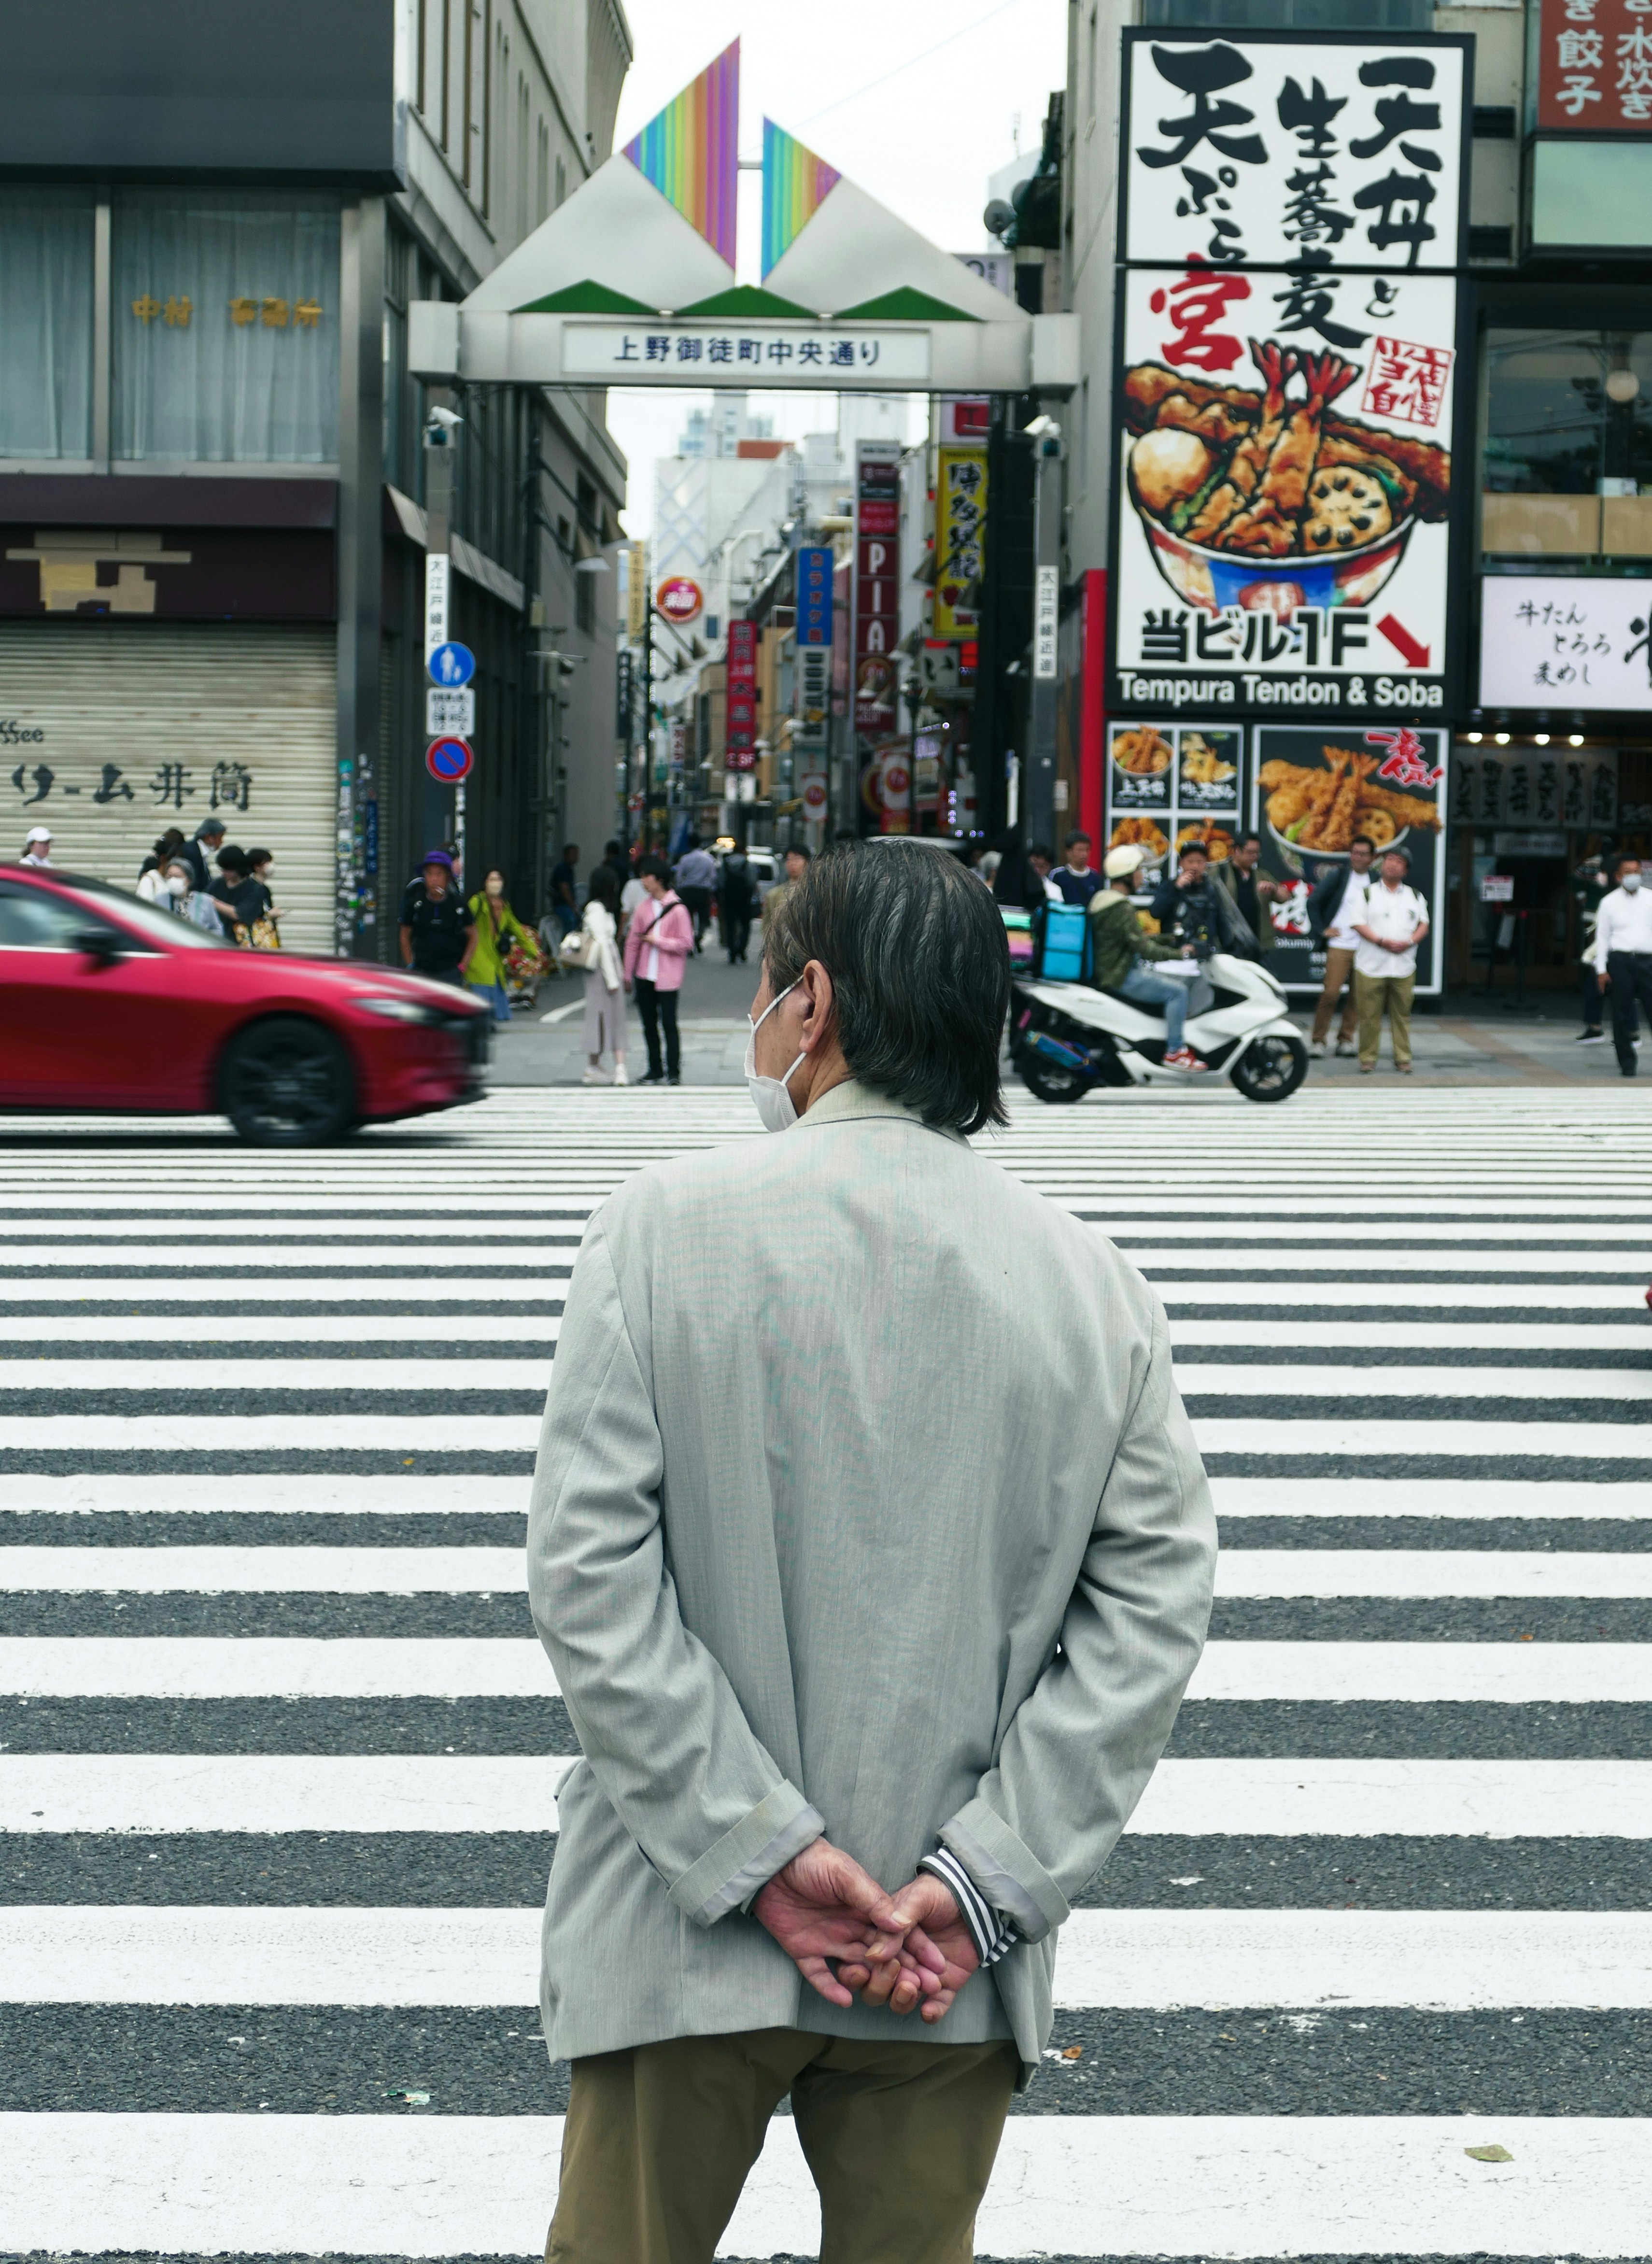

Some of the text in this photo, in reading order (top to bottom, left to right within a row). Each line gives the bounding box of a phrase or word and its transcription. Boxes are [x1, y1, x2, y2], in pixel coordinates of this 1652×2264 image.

[614, 335, 881, 367] 上野御徒町中央通り
[430, 560, 445, 646] 大江戸線近
[866, 541, 887, 653] PIA
[1514, 598, 1589, 627] 牛たん
[1141, 608, 1370, 666] 当ビル1F
[1553, 632, 1611, 657] とろろ
[1117, 672, 1443, 708] Tempura Tendon & Soba
[1534, 660, 1592, 687] 麦めし
